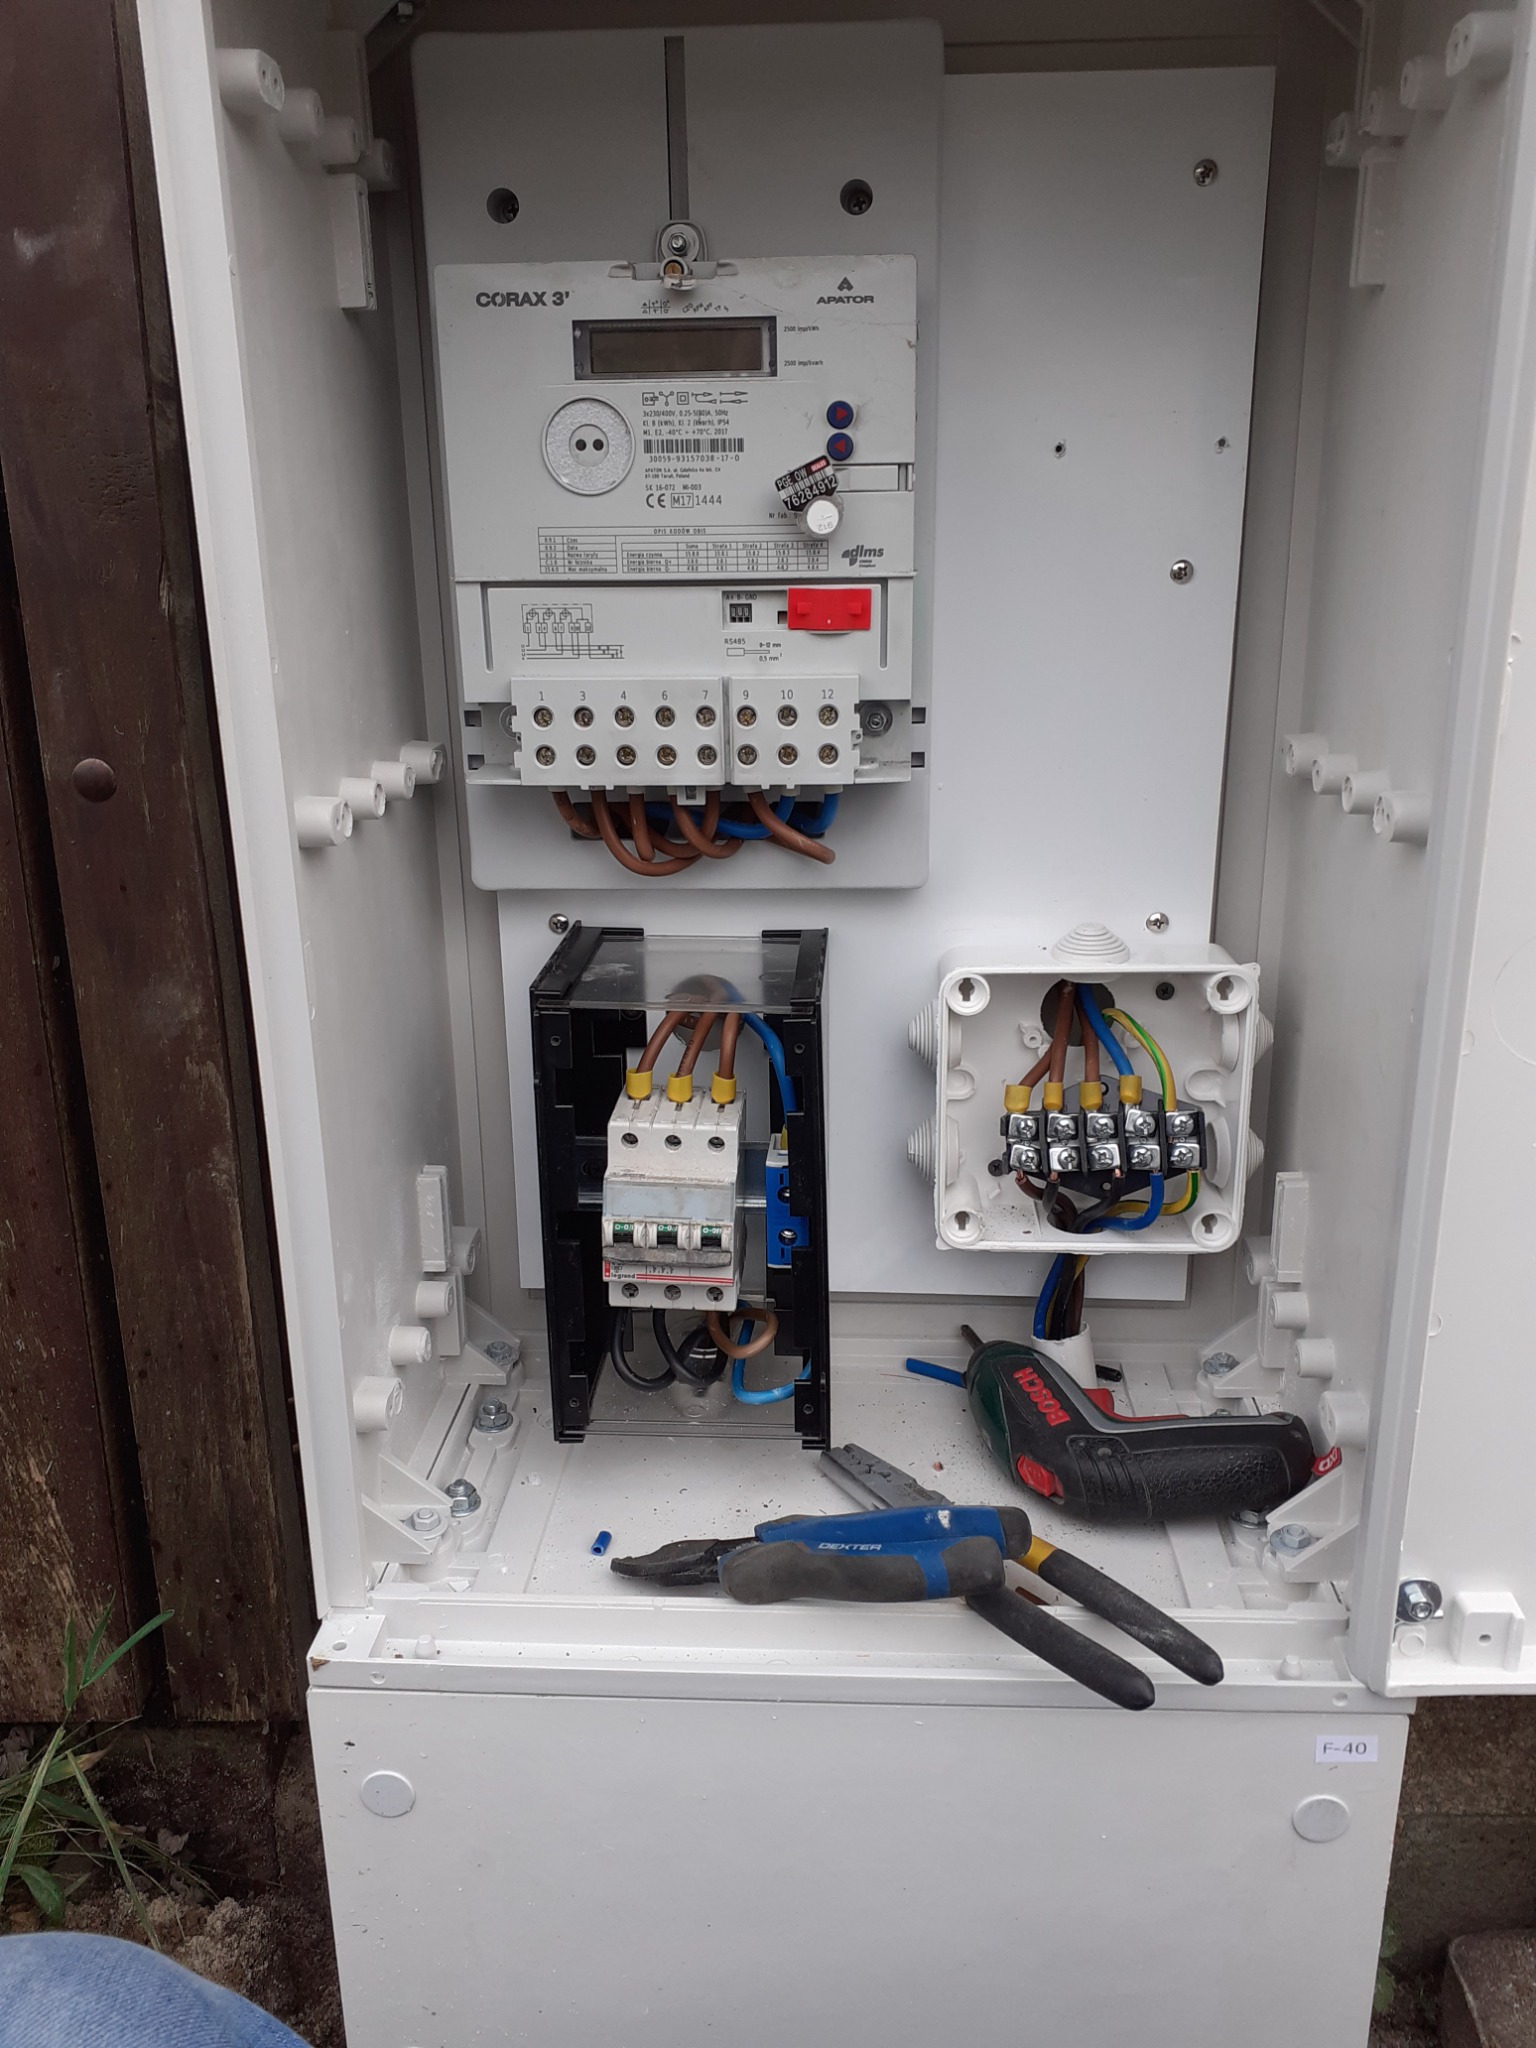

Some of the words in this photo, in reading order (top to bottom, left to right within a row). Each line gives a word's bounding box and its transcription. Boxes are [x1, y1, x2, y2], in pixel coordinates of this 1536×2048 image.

[475, 291, 547, 308] CORAX
[816, 295, 875, 304] APATOR
[714, 409, 729, 417] 50Hz
[717, 418, 730, 426] IP54
[776, 474, 794, 490] PGE
[794, 467, 808, 481] OW
[784, 475, 837, 510] 76284912
[672, 495, 692, 506] M17
[695, 494, 722, 506] 1444
[850, 544, 884, 558] dlms
[539, 691, 544, 701] 1
[580, 691, 586, 701] 3
[620, 691, 627, 700] 4
[662, 690, 668, 700] 6
[702, 690, 709, 700] 7
[743, 690, 749, 700] 9
[780, 689, 793, 700] 10
[821, 689, 834, 699] 12
[611, 1272, 636, 1280] legrand
[1012, 1366, 1071, 1427] BOSCH
[818, 1542, 882, 1551] DEXTER
[1323, 1741, 1367, 1755] F-40
